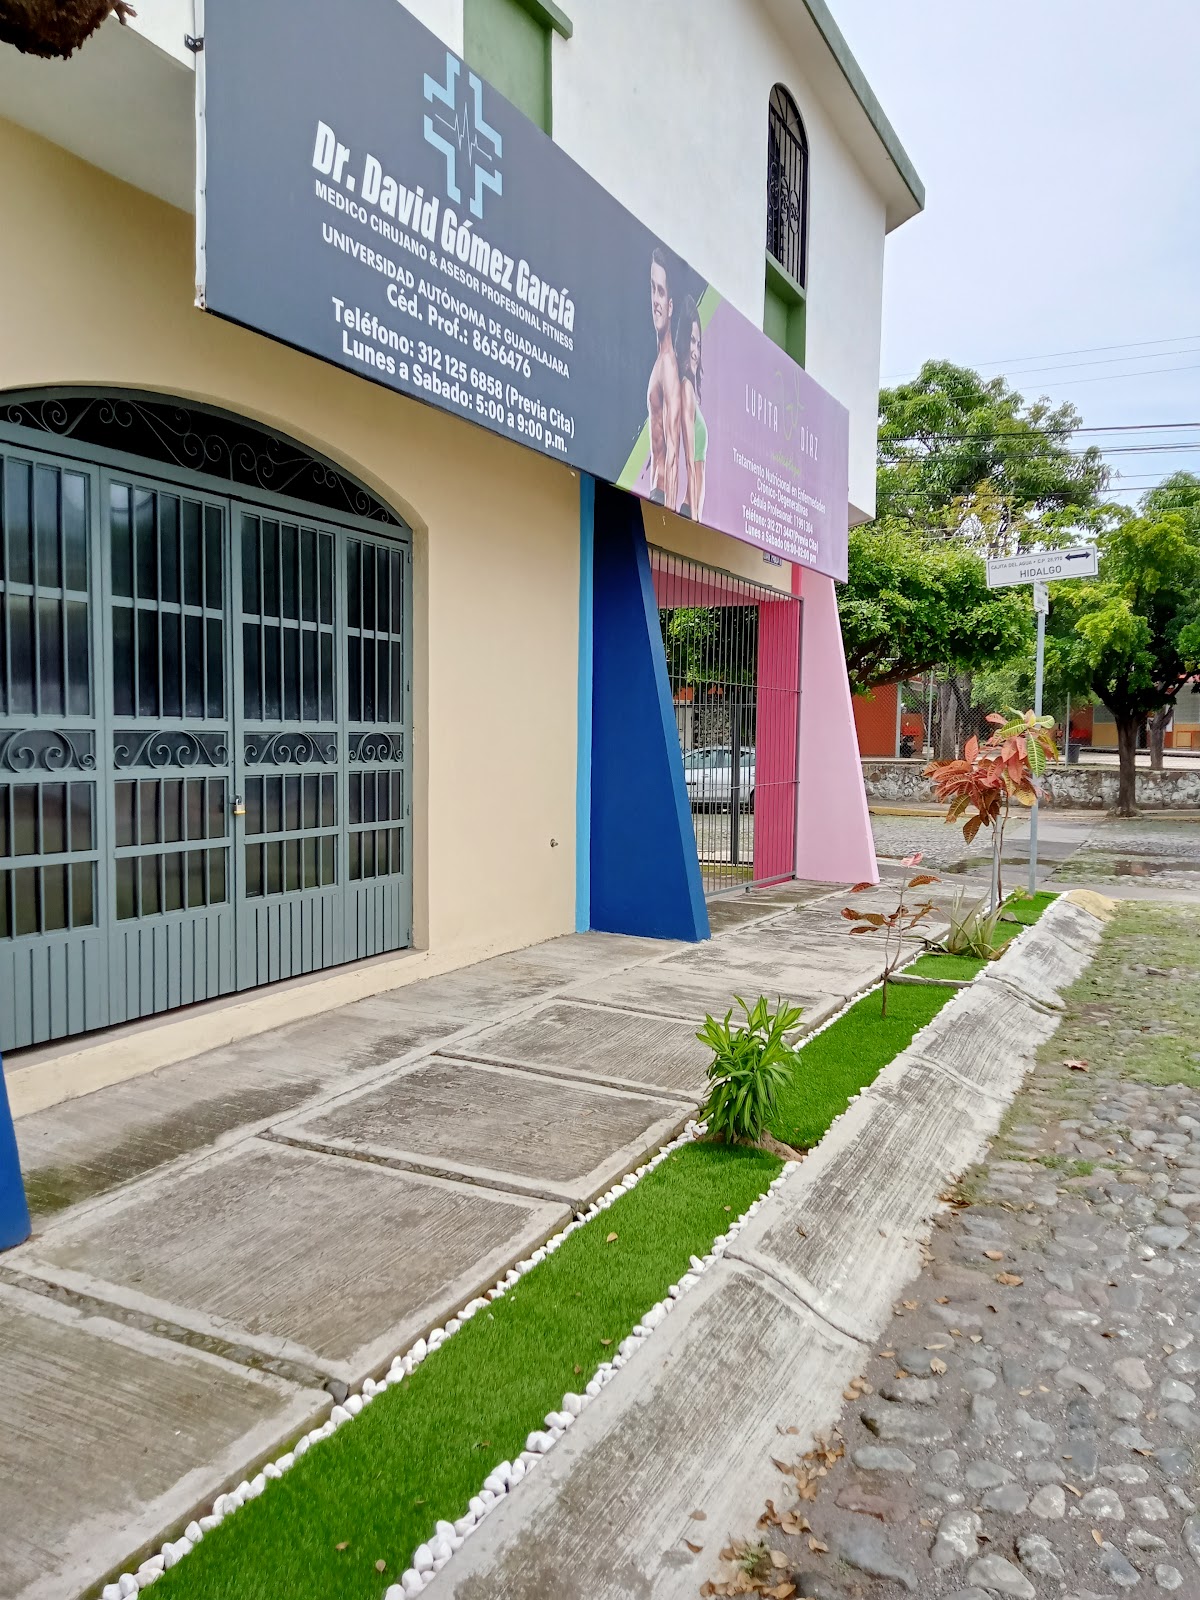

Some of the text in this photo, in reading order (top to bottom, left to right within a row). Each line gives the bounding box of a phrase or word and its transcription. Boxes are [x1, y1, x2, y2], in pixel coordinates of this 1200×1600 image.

[312, 120, 575, 332] Dr. David Gómez García
[315, 179, 574, 351] MEDICO CIRUJANO & ASESOR PROFESIONAL FITNESS
[322, 222, 570, 379] UNIVERSIDAD AUTÓNOMA DE GUADALAJARA
[387, 283, 531, 378] Céd. Prof.: 8656476
[332, 296, 575, 439] Teléfono: 312 125 6858 (Previa Cita)
[342, 329, 568, 453] Lunes a Sabado: 5:00 a 9:00 p.m.
[745, 384, 778, 432] LUPITA
[733, 447, 764, 478] Tratamiento
[765, 467, 791, 493] Nutricional
[791, 485, 798, 496] en
[797, 487, 826, 514] Enfermedades
[742, 504, 767, 527] Teléfono:
[750, 491, 767, 511] Cédula
[745, 521, 761, 539] Lunes
[761, 530, 765, 541] a
[765, 531, 784, 550] Sabado
[1020, 565, 1062, 578] HIDALGO
